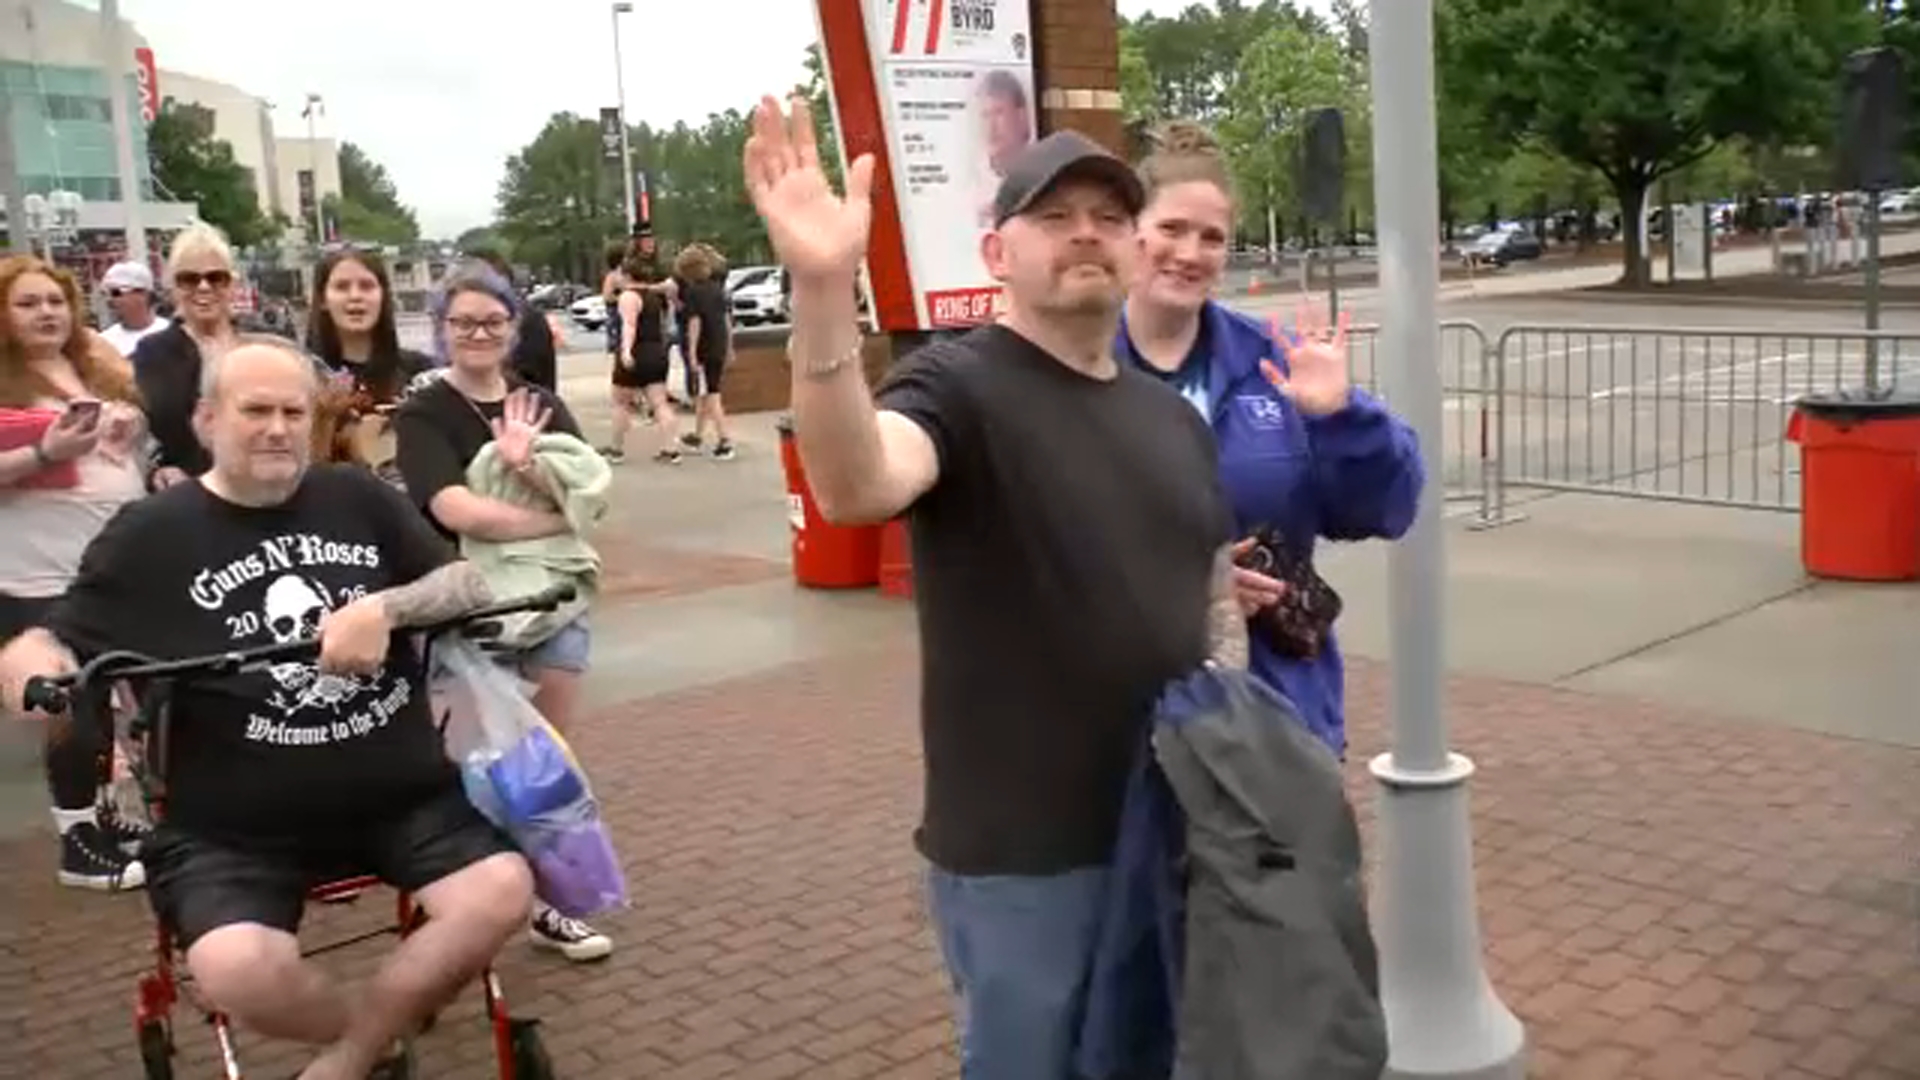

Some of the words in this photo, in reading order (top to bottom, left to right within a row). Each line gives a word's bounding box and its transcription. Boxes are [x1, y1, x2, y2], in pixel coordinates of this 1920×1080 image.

[951, 5, 995, 31] BYRD
[935, 296, 970, 319] RING
[971, 293, 991, 317] OF
[189, 553, 265, 610] Guns
[296, 533, 380, 568] Roses
[225, 611, 259, 640] 20
[244, 714, 330, 745] Welcome
[331, 722, 350, 741] to
[349, 712, 375, 736] the
